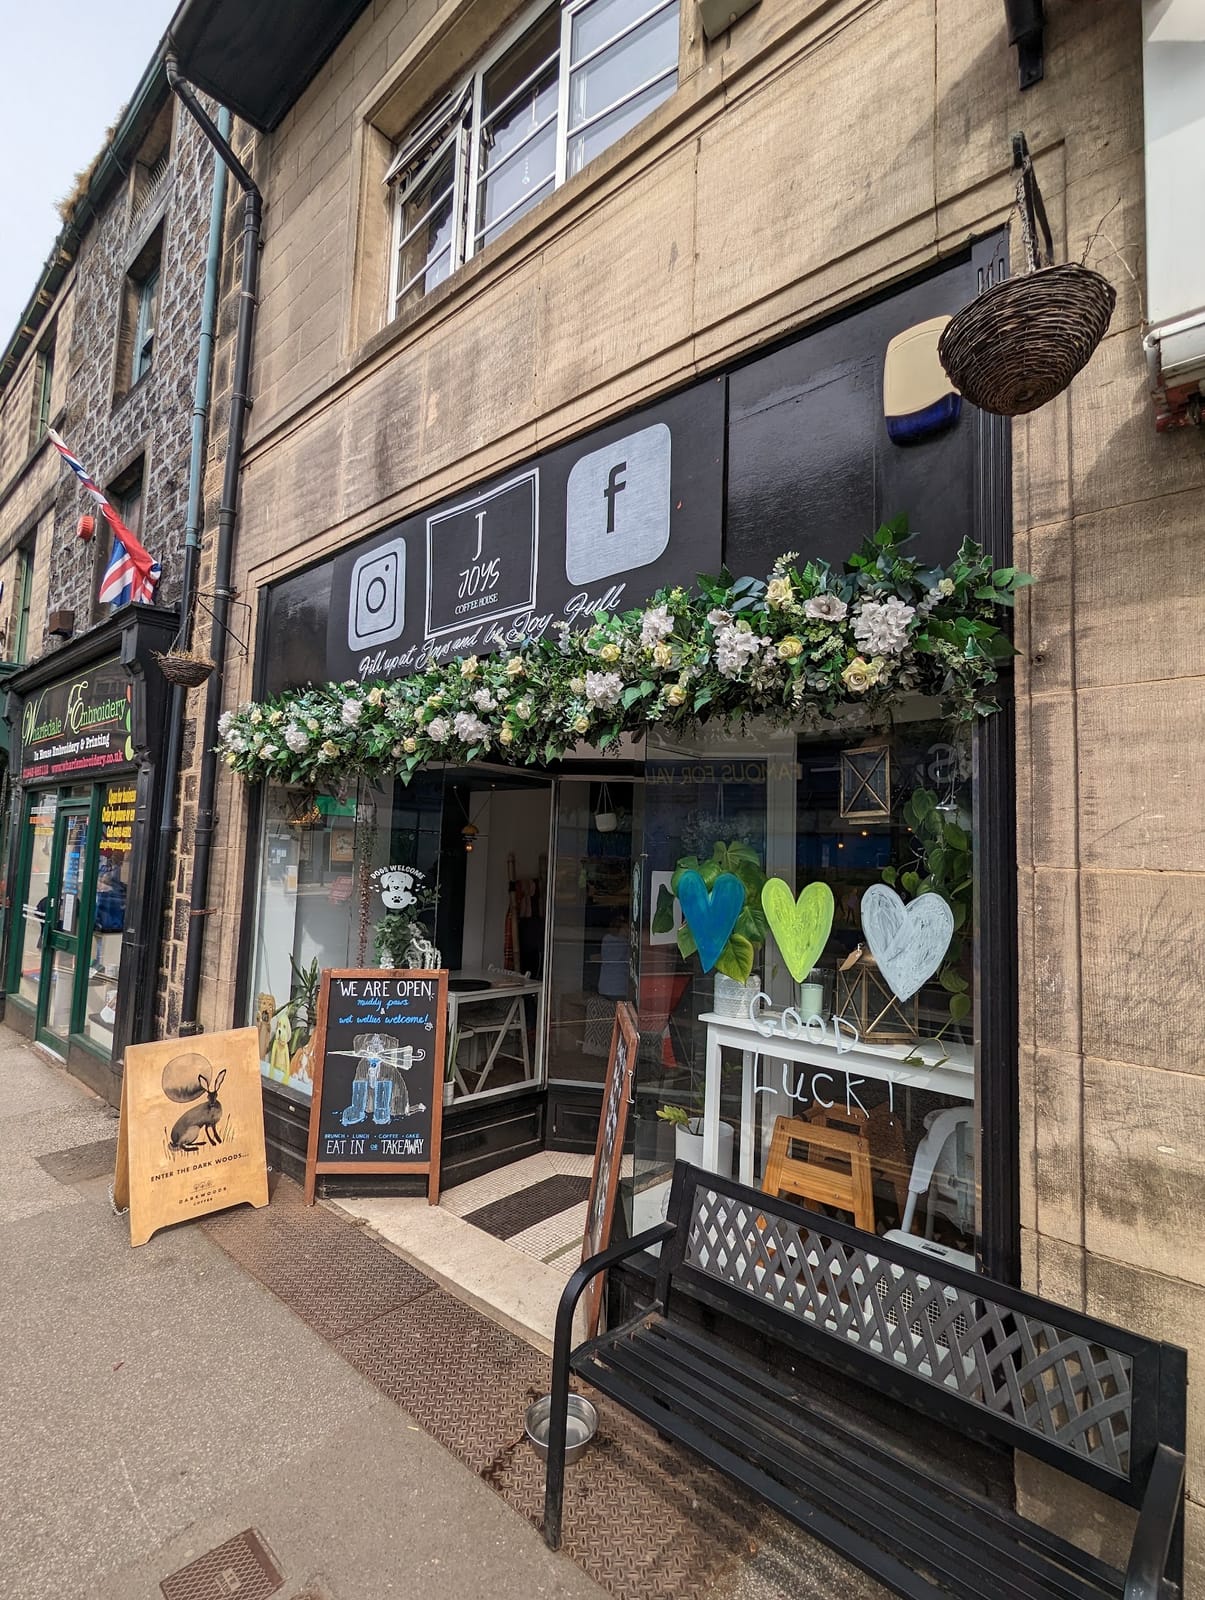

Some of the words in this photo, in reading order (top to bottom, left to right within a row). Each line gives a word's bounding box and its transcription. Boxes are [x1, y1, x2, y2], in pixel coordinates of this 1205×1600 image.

[472, 511, 487, 561] J
[458, 557, 500, 598] JOYS
[455, 599, 479, 615] COFFEE
[479, 593, 499, 606] HOUSE
[450, 626, 483, 650] and
[64, 681, 126, 734] Embroidery
[86, 732, 110, 750] Printing
[369, 866, 390, 880] DOGS
[389, 864, 426, 880] WELCOME
[340, 980, 358, 997] WE
[363, 980, 390, 997] ARE
[397, 980, 432, 997] OPEN
[357, 997, 381, 1011] muddy
[386, 999, 409, 1009] paws
[339, 1014, 353, 1023] wet
[357, 1014, 381, 1023] wellies
[326, 1140, 347, 1154] EAT
[350, 1140, 365, 1154] IN
[381, 1139, 425, 1154] TAKEAWAY
[150, 1171, 174, 1182] ENTER
[177, 1167, 190, 1175] THE
[192, 1161, 212, 1171] DARK
